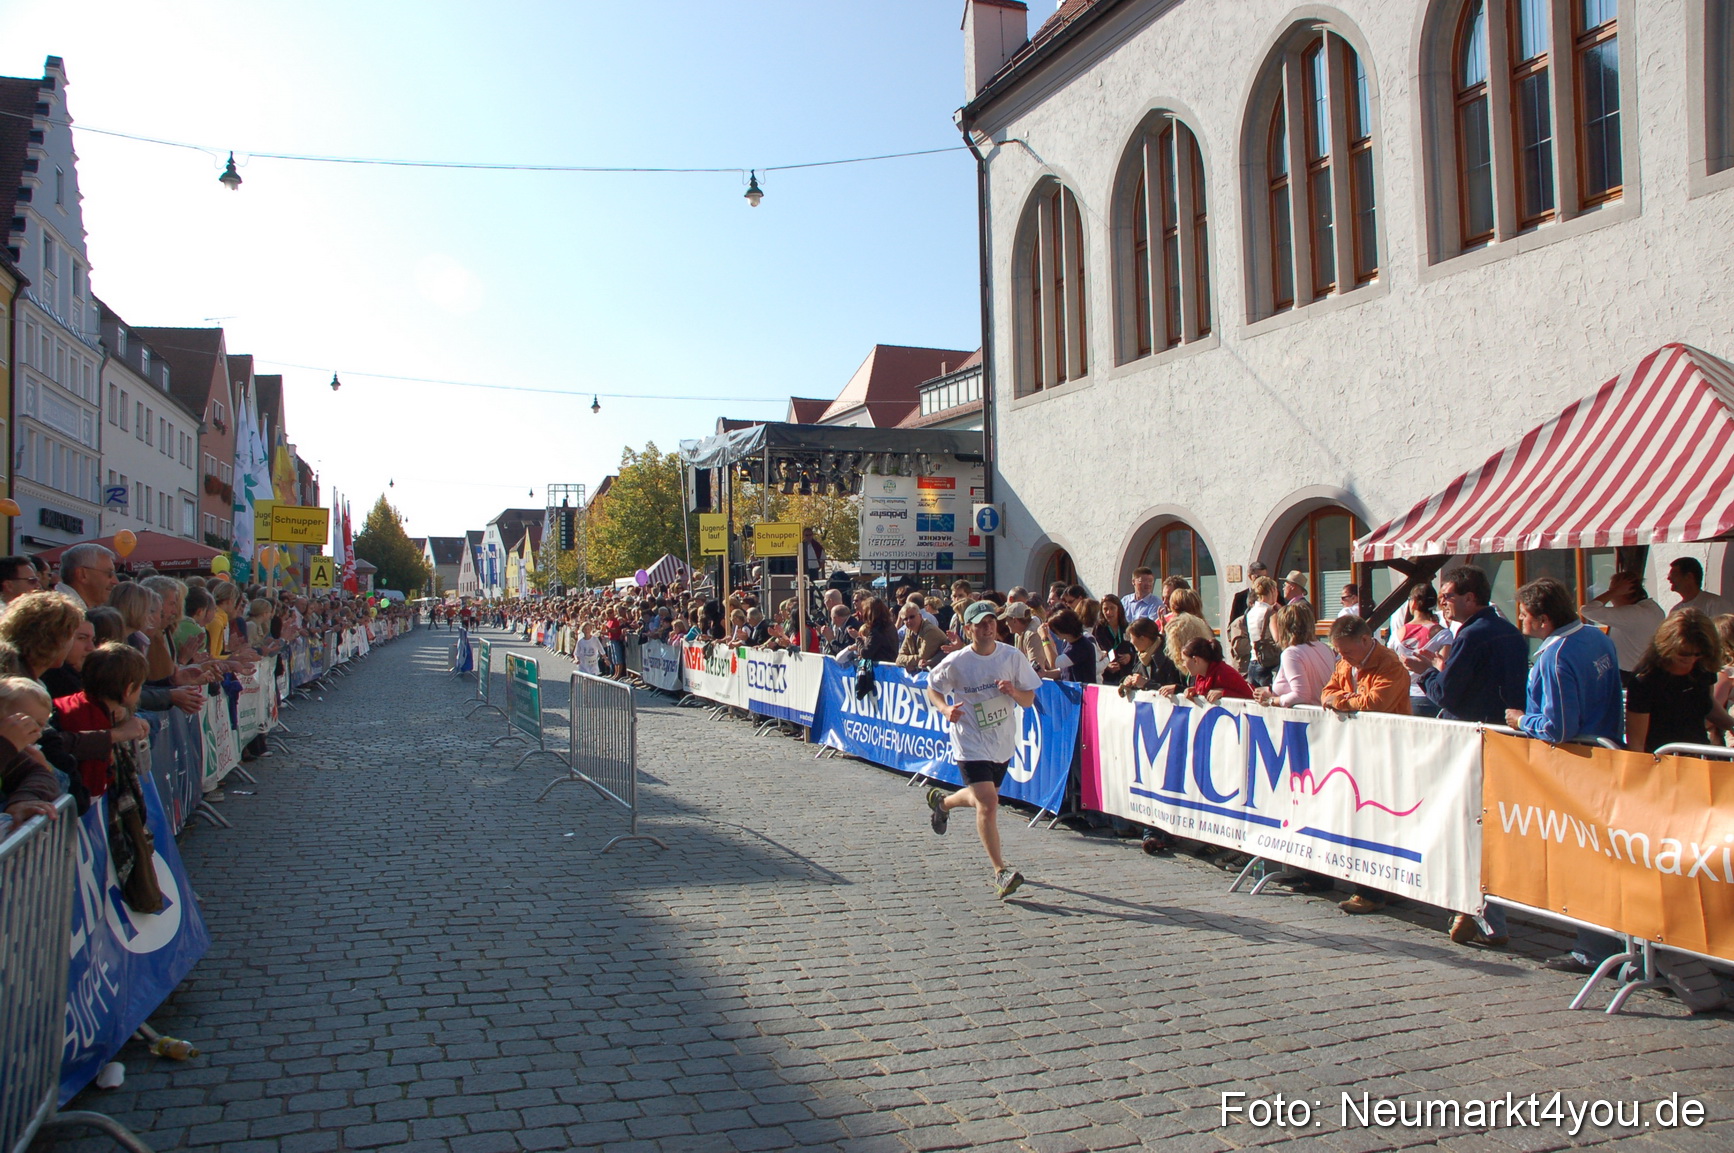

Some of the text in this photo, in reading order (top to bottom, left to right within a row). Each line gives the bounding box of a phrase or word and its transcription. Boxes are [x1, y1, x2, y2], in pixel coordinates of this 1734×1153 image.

[869, 509, 908, 519] Pröbster
[274, 516, 325, 526] Schnupper-
[291, 527, 308, 535] lauf
[701, 525, 727, 533] Jugend-
[757, 532, 798, 540] Schnupper-
[315, 565, 328, 581] A
[987, 707, 1008, 721] 5171
[1133, 701, 1310, 809] MCM
[1129, 801, 1151, 817] MICRO
[1257, 834, 1313, 859] COMPUTER
[1325, 854, 1423, 888] KASSENSYSTEME
